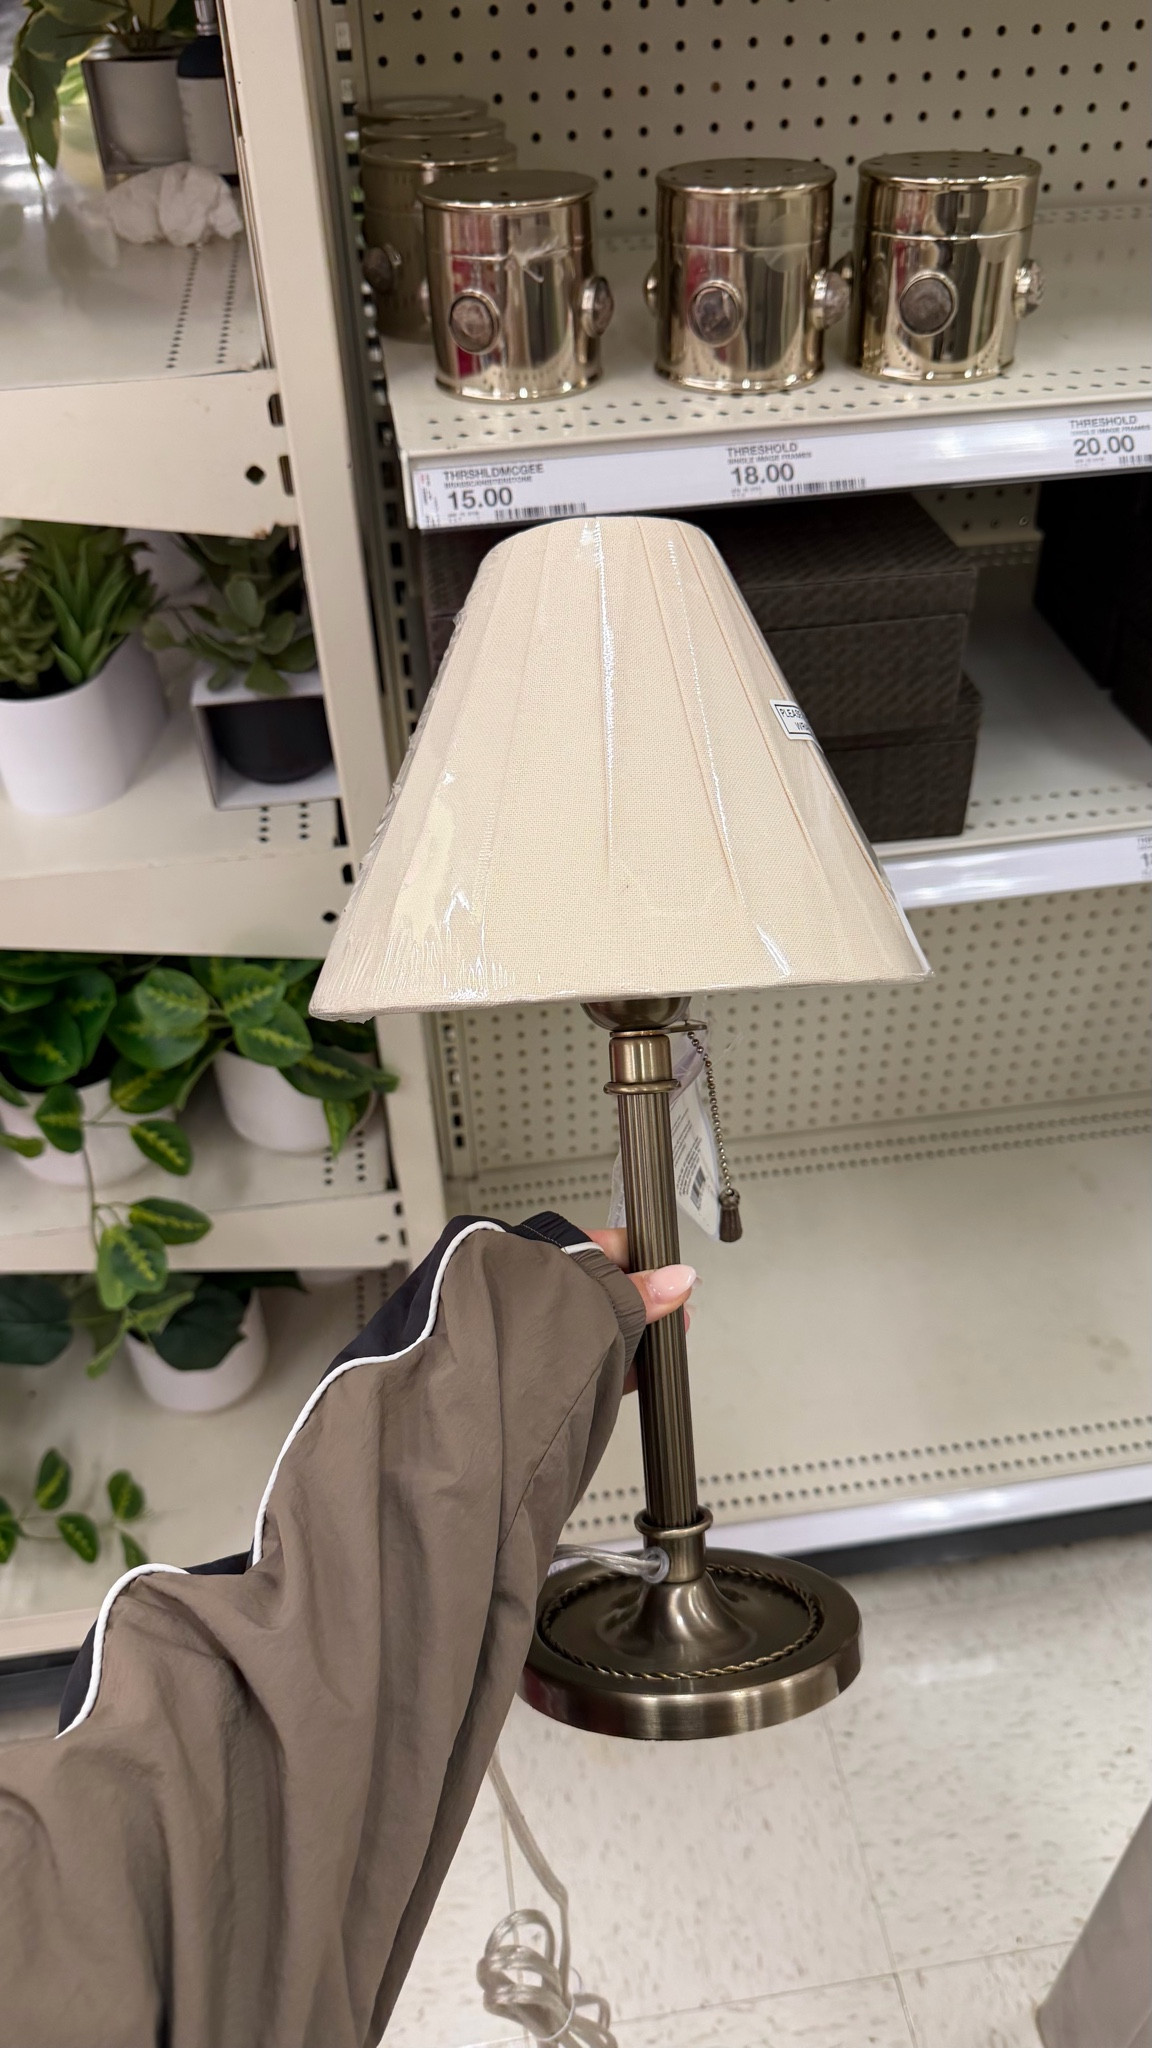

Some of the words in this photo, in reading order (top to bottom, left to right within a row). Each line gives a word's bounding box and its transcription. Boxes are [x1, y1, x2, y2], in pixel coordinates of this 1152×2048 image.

[1069, 415, 1137, 429] THRESHOLD
[727, 443, 798, 457] THRESHOLD
[1074, 434, 1135, 457] 20.00
[731, 462, 794, 486] 18.00
[448, 487, 512, 510] 15.00
